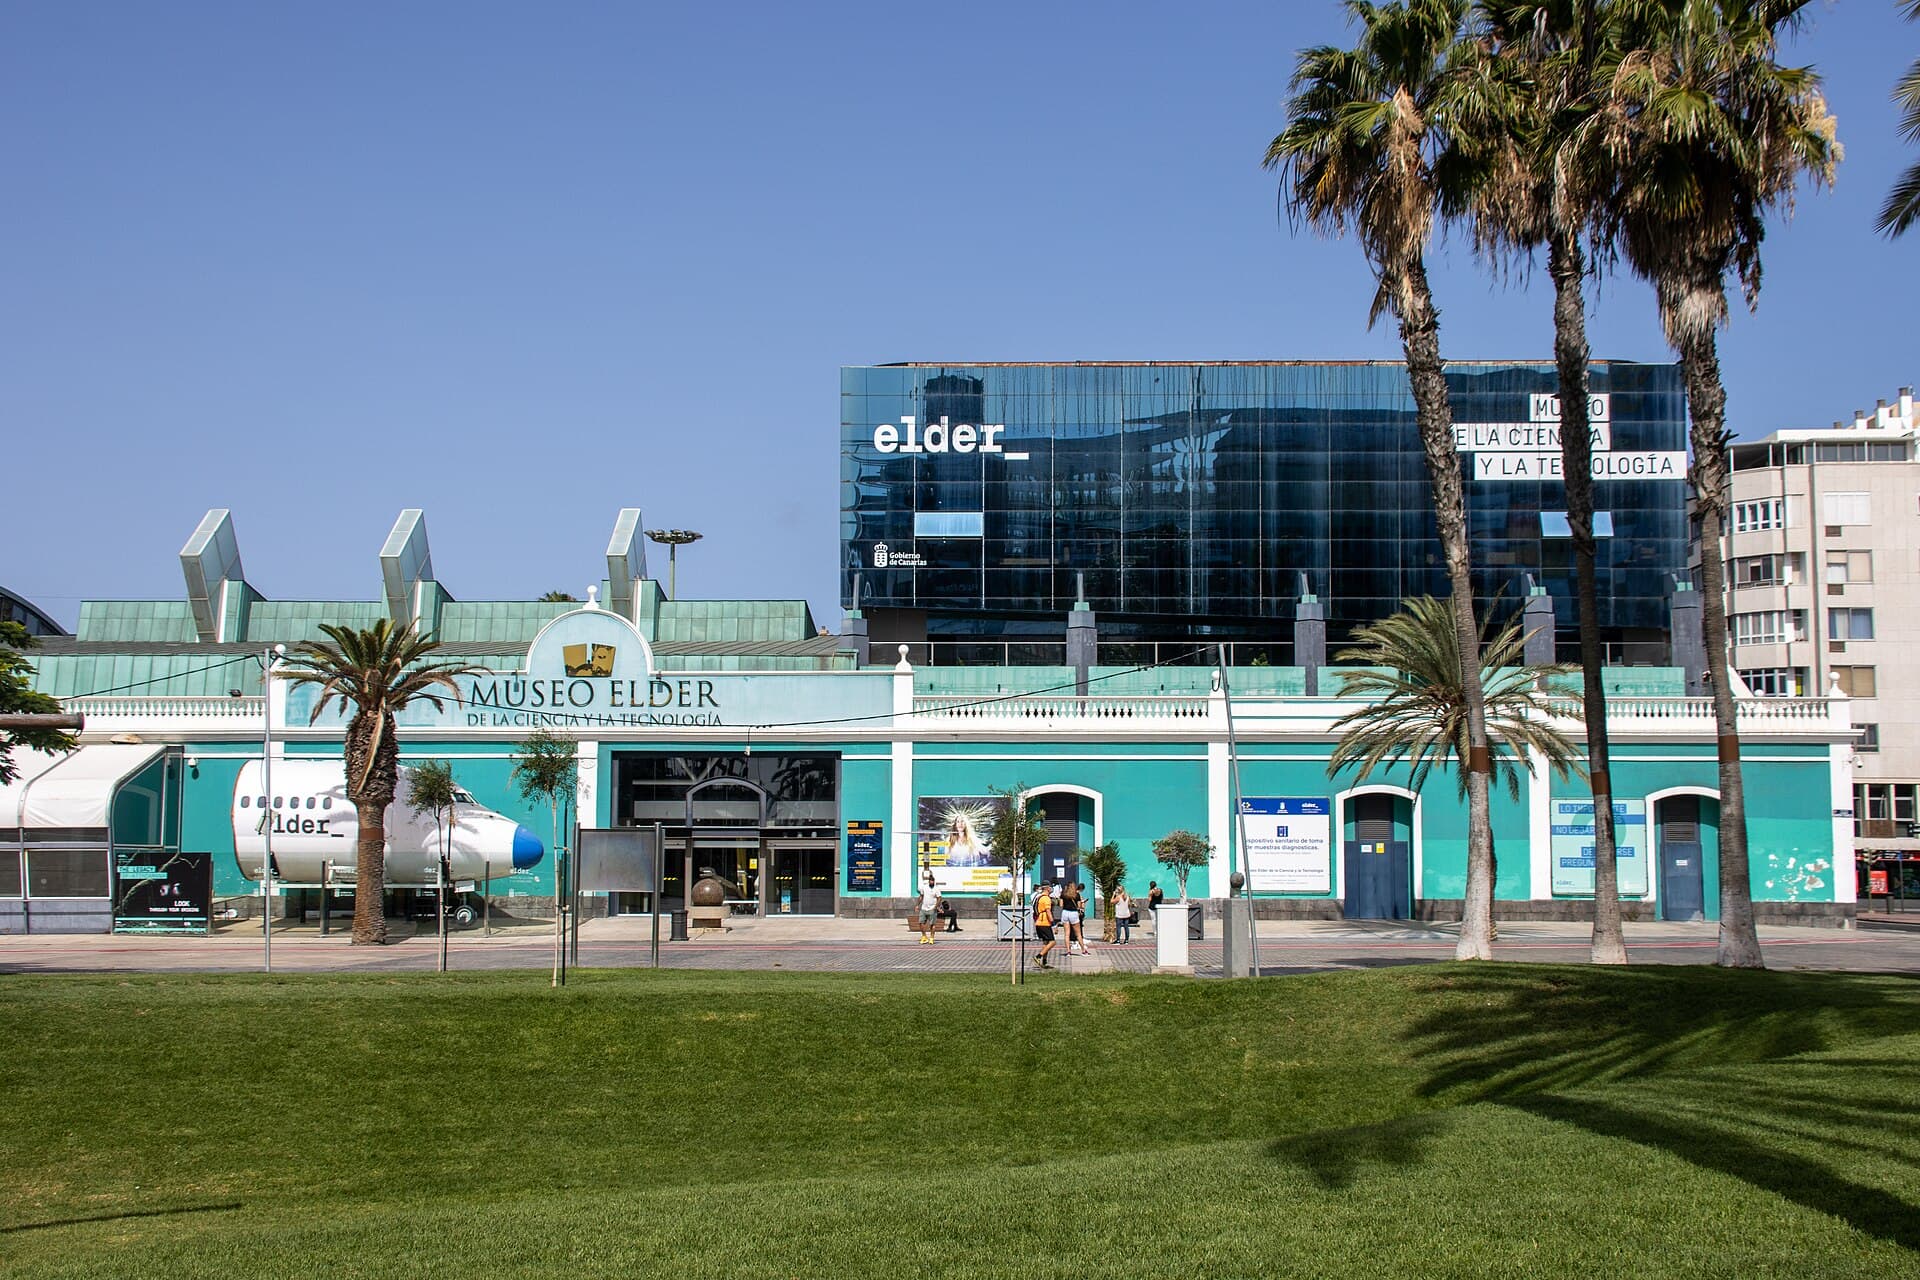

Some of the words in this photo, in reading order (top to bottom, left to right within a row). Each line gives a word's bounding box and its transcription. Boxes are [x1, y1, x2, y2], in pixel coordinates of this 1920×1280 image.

[1536, 399, 1604, 416] MUO
[874, 416, 1029, 460] elder_
[1456, 428, 1467, 446] E
[1475, 428, 1501, 446] LA
[1509, 428, 1603, 446] CIENA
[1480, 458, 1493, 475] Y
[1502, 458, 1528, 475] LA
[1536, 454, 1673, 475] TEOLOGÍA
[471, 679, 594, 707] MUSEO
[610, 680, 719, 707] ELDER
[467, 714, 486, 727] DE
[493, 714, 510, 727] LA
[514, 714, 580, 727] CIENCIA
[582, 713, 594, 727] Y
[598, 714, 615, 727] LA
[620, 711, 722, 727] TECNOLOGÍA
[1574, 804, 1626, 813] IMPOTE
[273, 814, 344, 837] lder_
